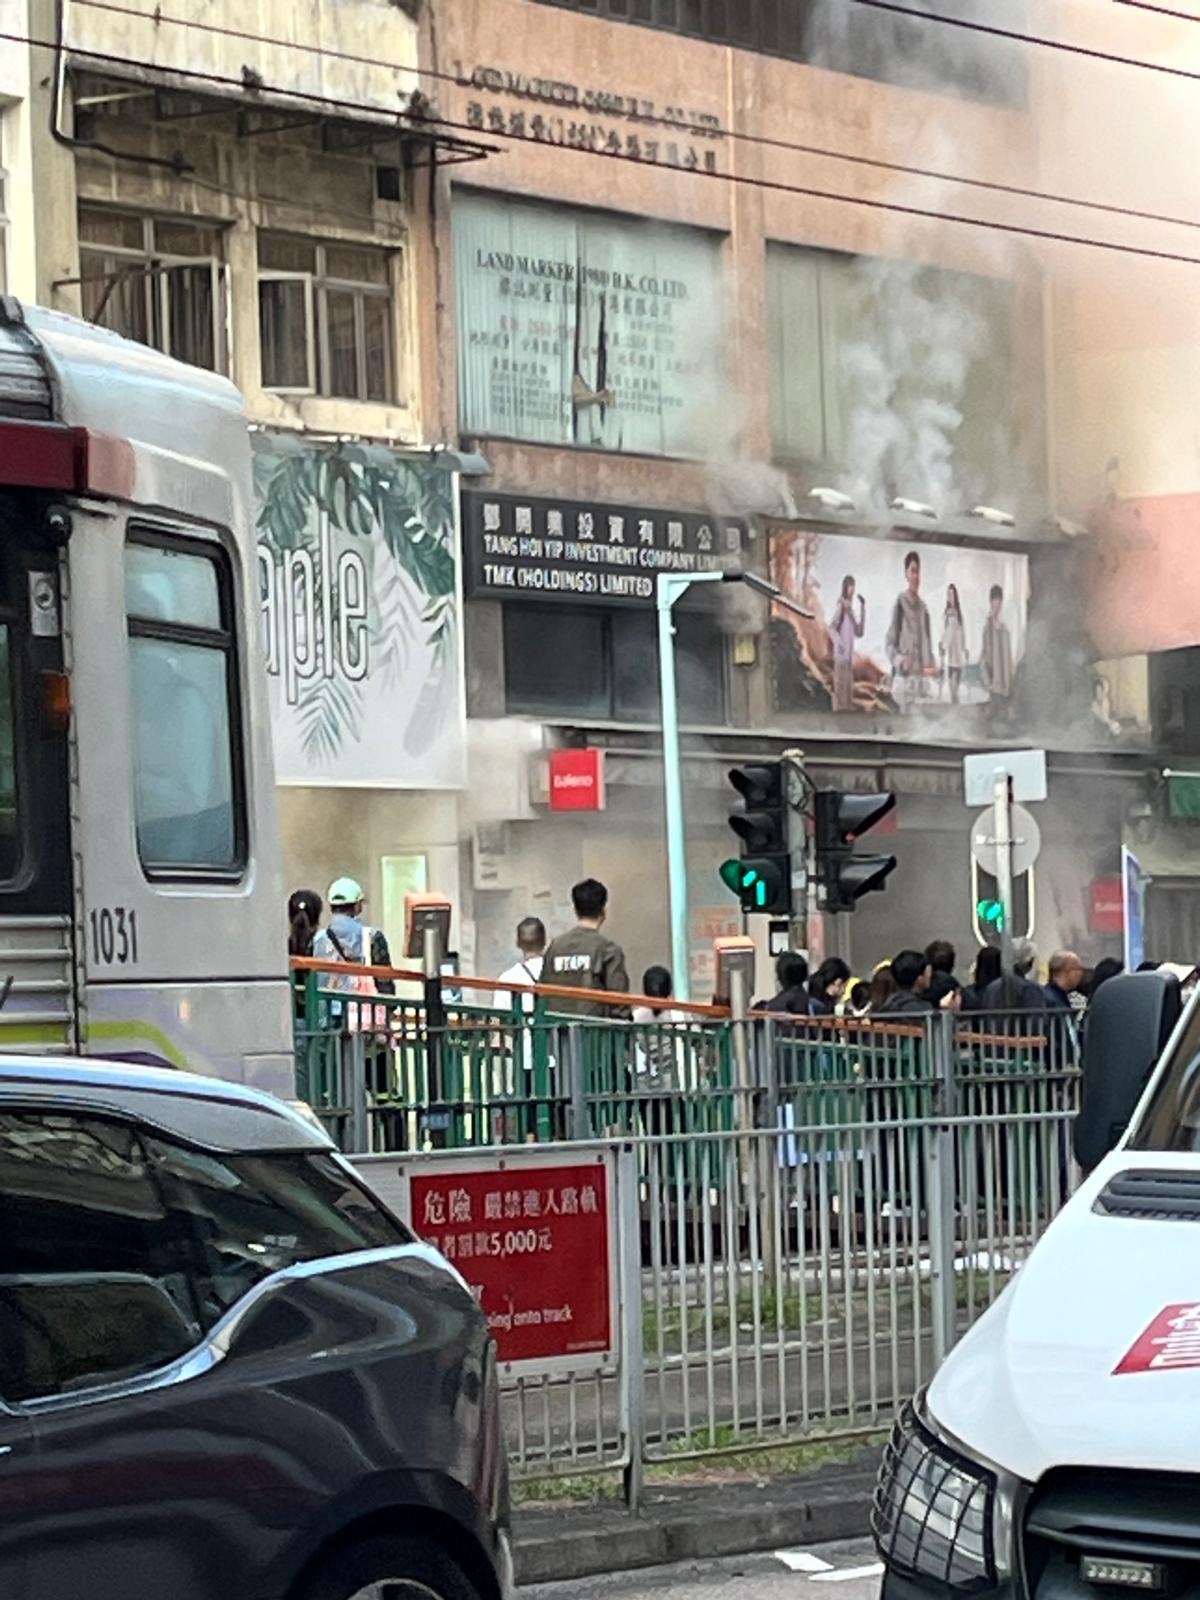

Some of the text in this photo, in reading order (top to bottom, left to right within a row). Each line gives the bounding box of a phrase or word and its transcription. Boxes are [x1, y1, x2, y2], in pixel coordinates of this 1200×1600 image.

[483, 534, 518, 556] TANG
[519, 537, 543, 558] HOI
[544, 539, 563, 560] YIP
[565, 541, 638, 566] INVESTMENT
[639, 548, 695, 570] COMPANY
[483, 564, 653, 597] TMK (HOLDINGS) LIMITED
[91, 907, 138, 966] 1031
[423, 1187, 472, 1224] 危險
[514, 1310, 541, 1326] onto
[543, 1304, 573, 1323] track
